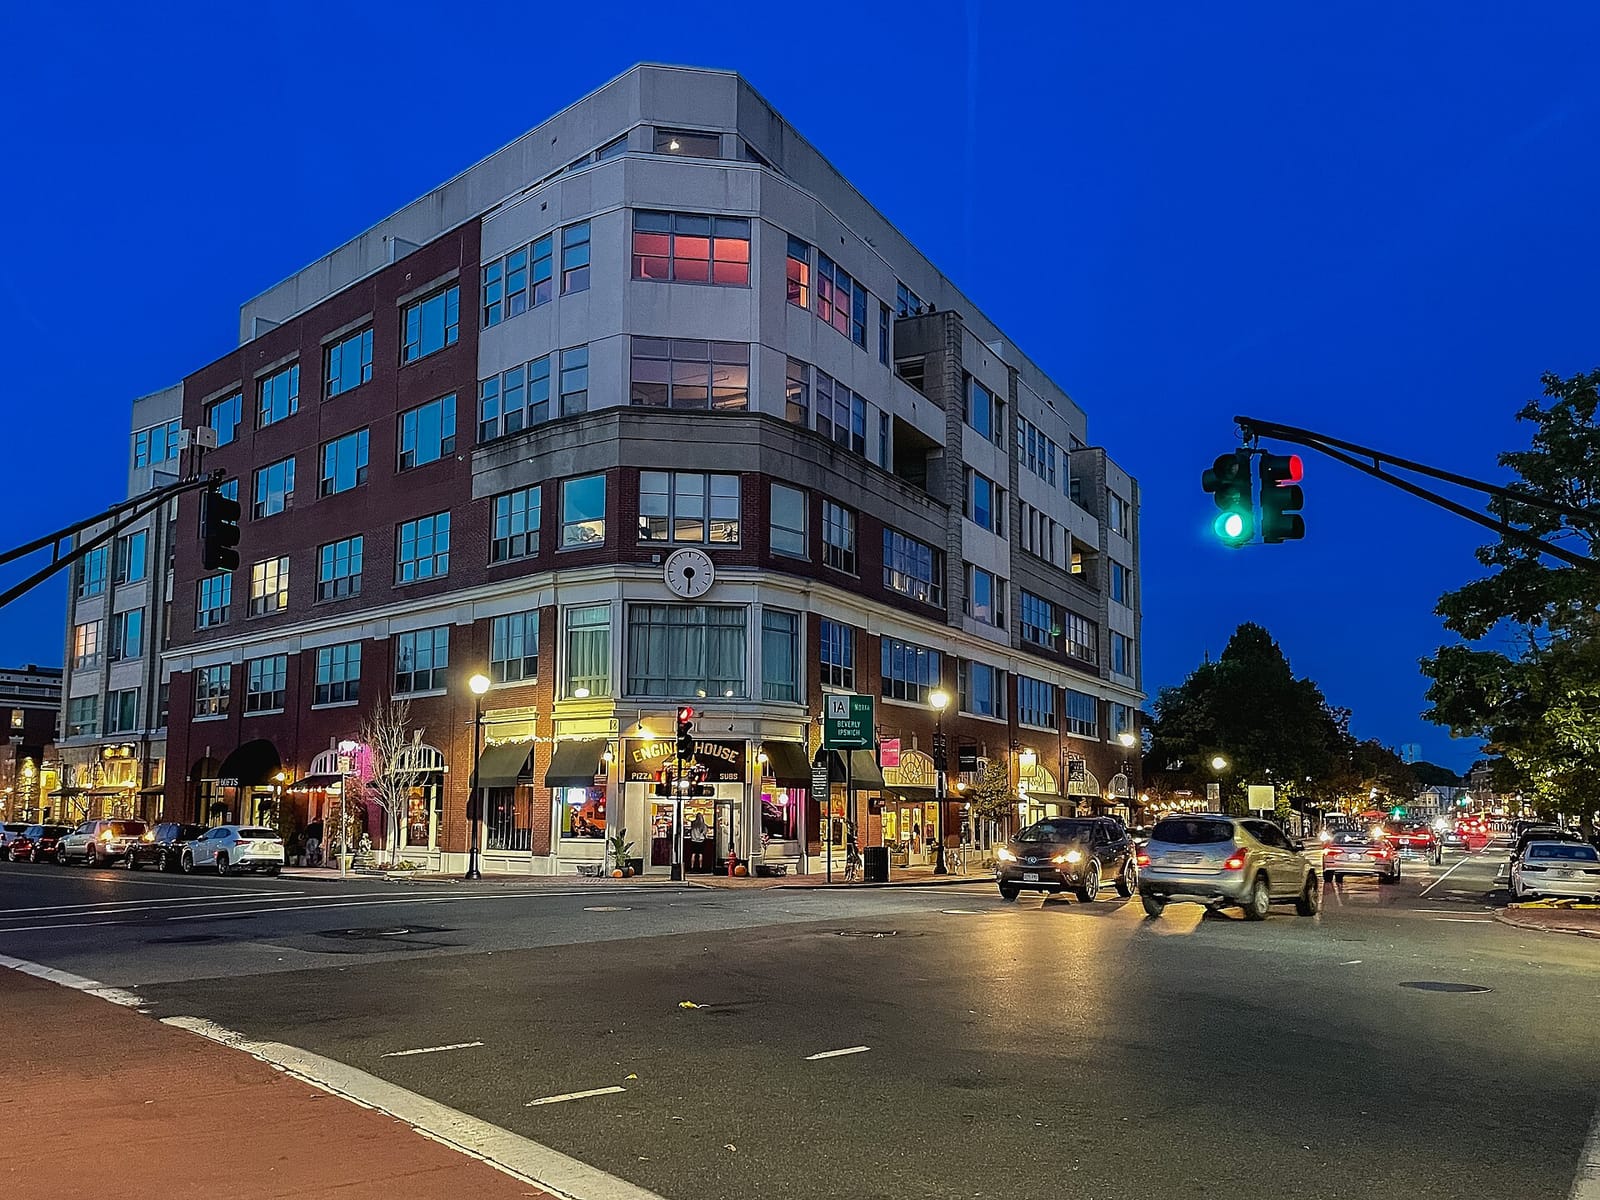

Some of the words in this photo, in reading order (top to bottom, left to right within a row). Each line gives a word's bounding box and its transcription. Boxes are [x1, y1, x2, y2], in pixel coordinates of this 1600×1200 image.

[833, 701, 846, 714] 1A
[837, 720, 861, 728] BEVERLY
[695, 741, 740, 764] HOUSE
[631, 772, 652, 780] PIZZA
[719, 772, 738, 780] SUBS
